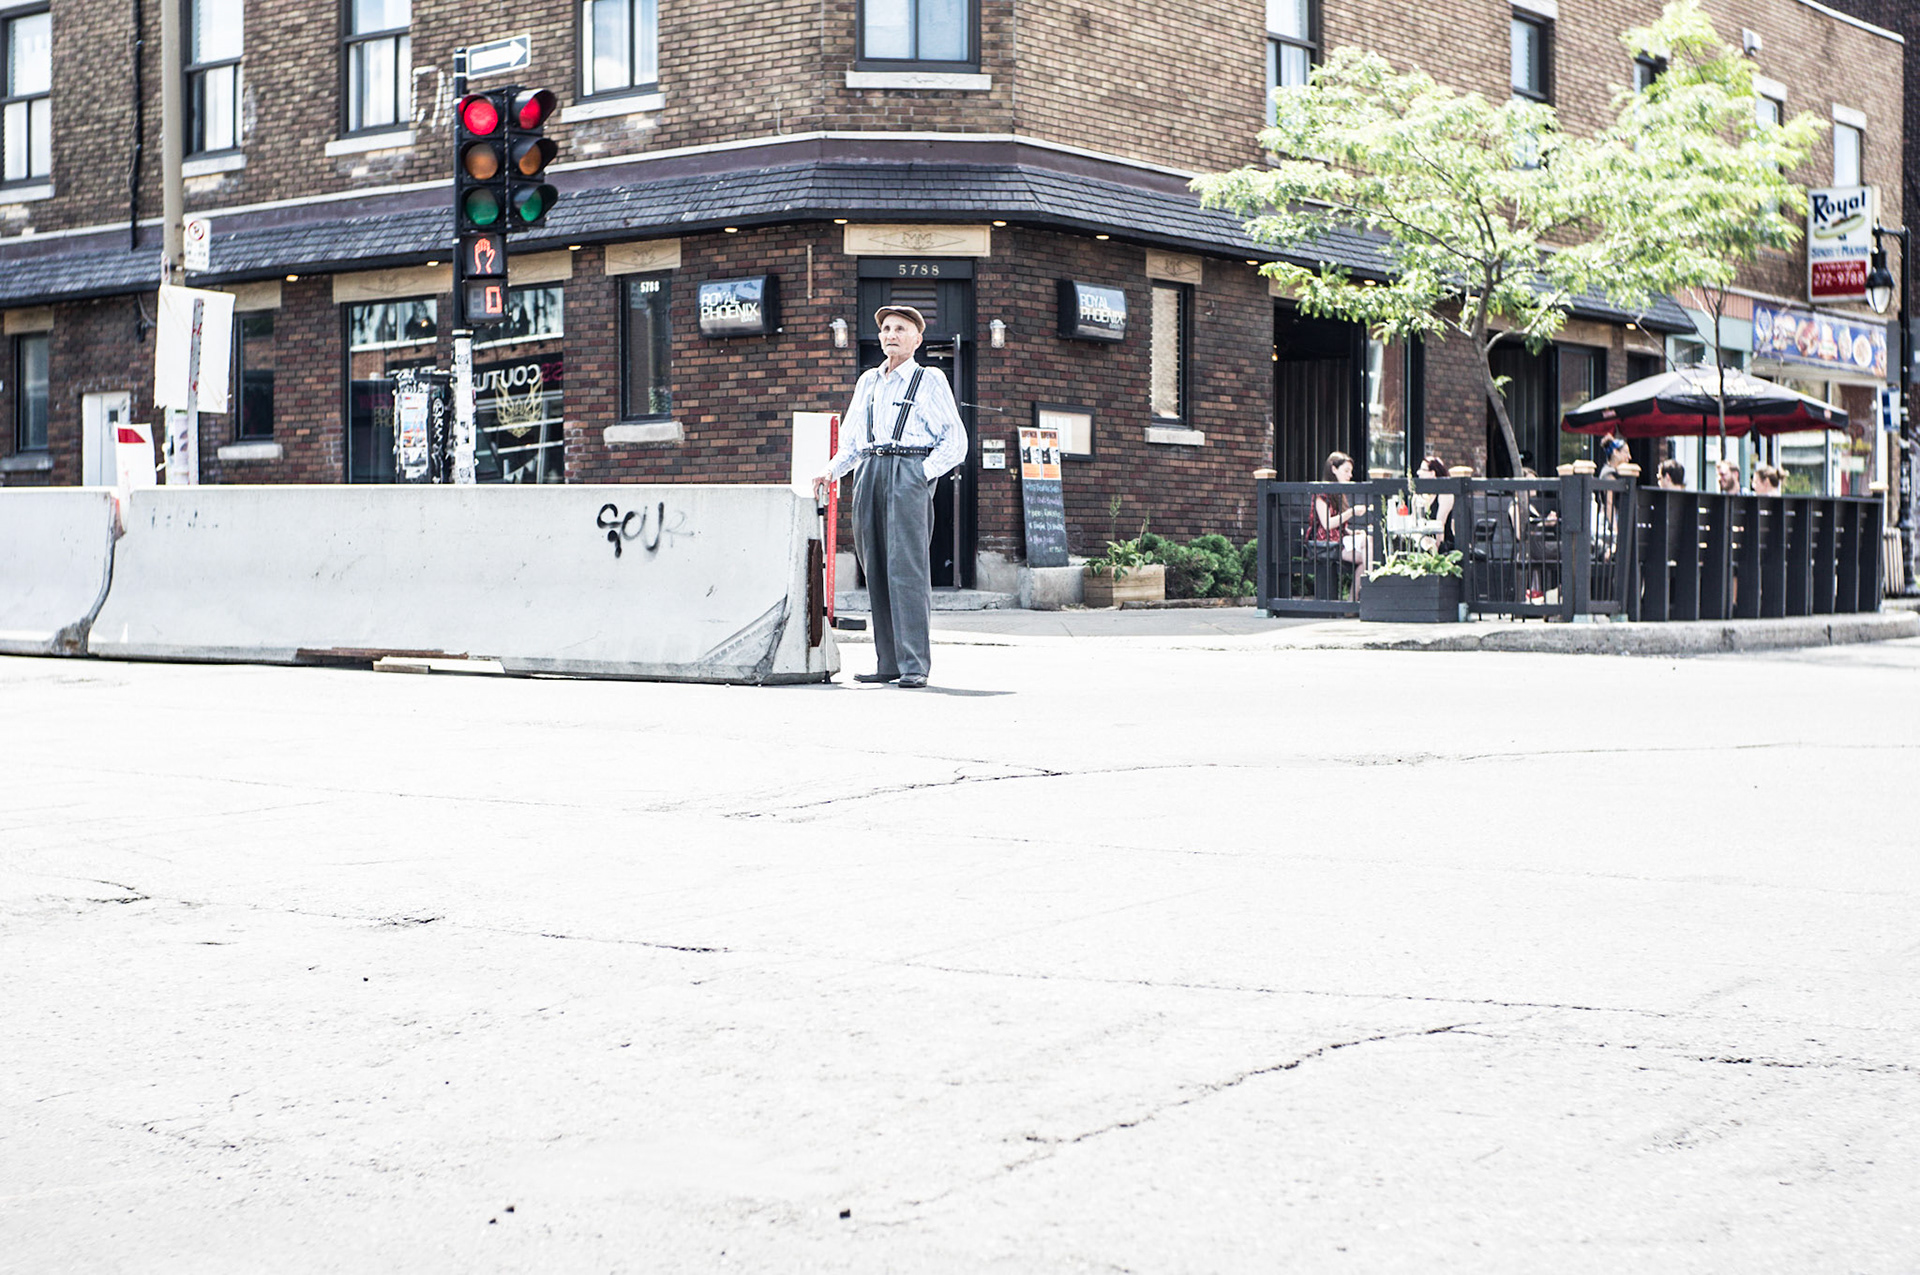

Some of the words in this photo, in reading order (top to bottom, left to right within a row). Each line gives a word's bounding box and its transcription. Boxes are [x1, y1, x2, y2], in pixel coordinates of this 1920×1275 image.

[1812, 190, 1866, 223] Royal
[898, 264, 940, 276] 5788
[640, 280, 660, 293] 5788
[701, 291, 740, 307] ROYAL
[1080, 293, 1110, 310] ROYAL
[701, 302, 759, 320] PHOENIX
[1080, 306, 1124, 325] PHOENIX
